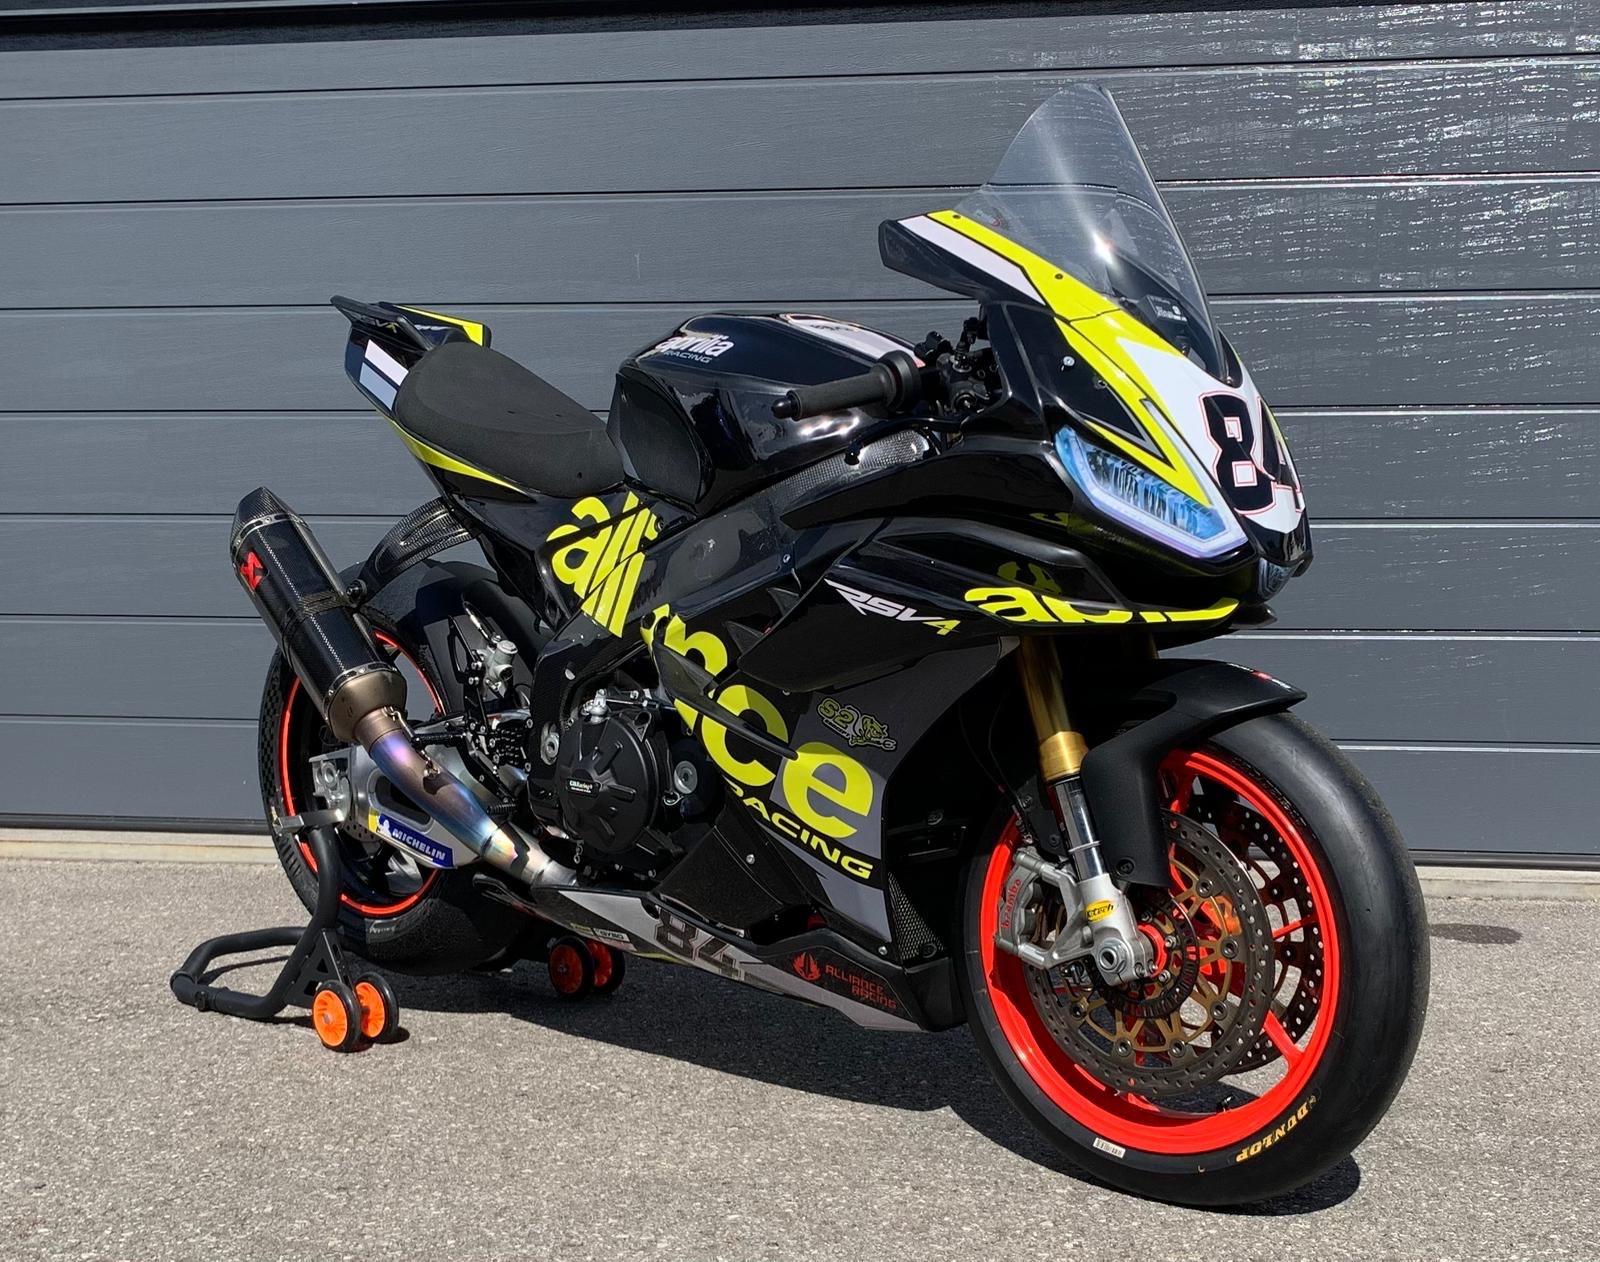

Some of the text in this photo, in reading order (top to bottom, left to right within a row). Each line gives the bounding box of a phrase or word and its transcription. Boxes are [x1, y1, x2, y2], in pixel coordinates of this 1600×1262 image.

[663, 351, 713, 363] RACING
[1199, 391, 1302, 513] 84
[823, 578, 961, 636] RSV4
[392, 828, 446, 860] MICHELIN
[1001, 879, 1022, 928] brembo
[1236, 1102, 1309, 1162] DUNLOP
